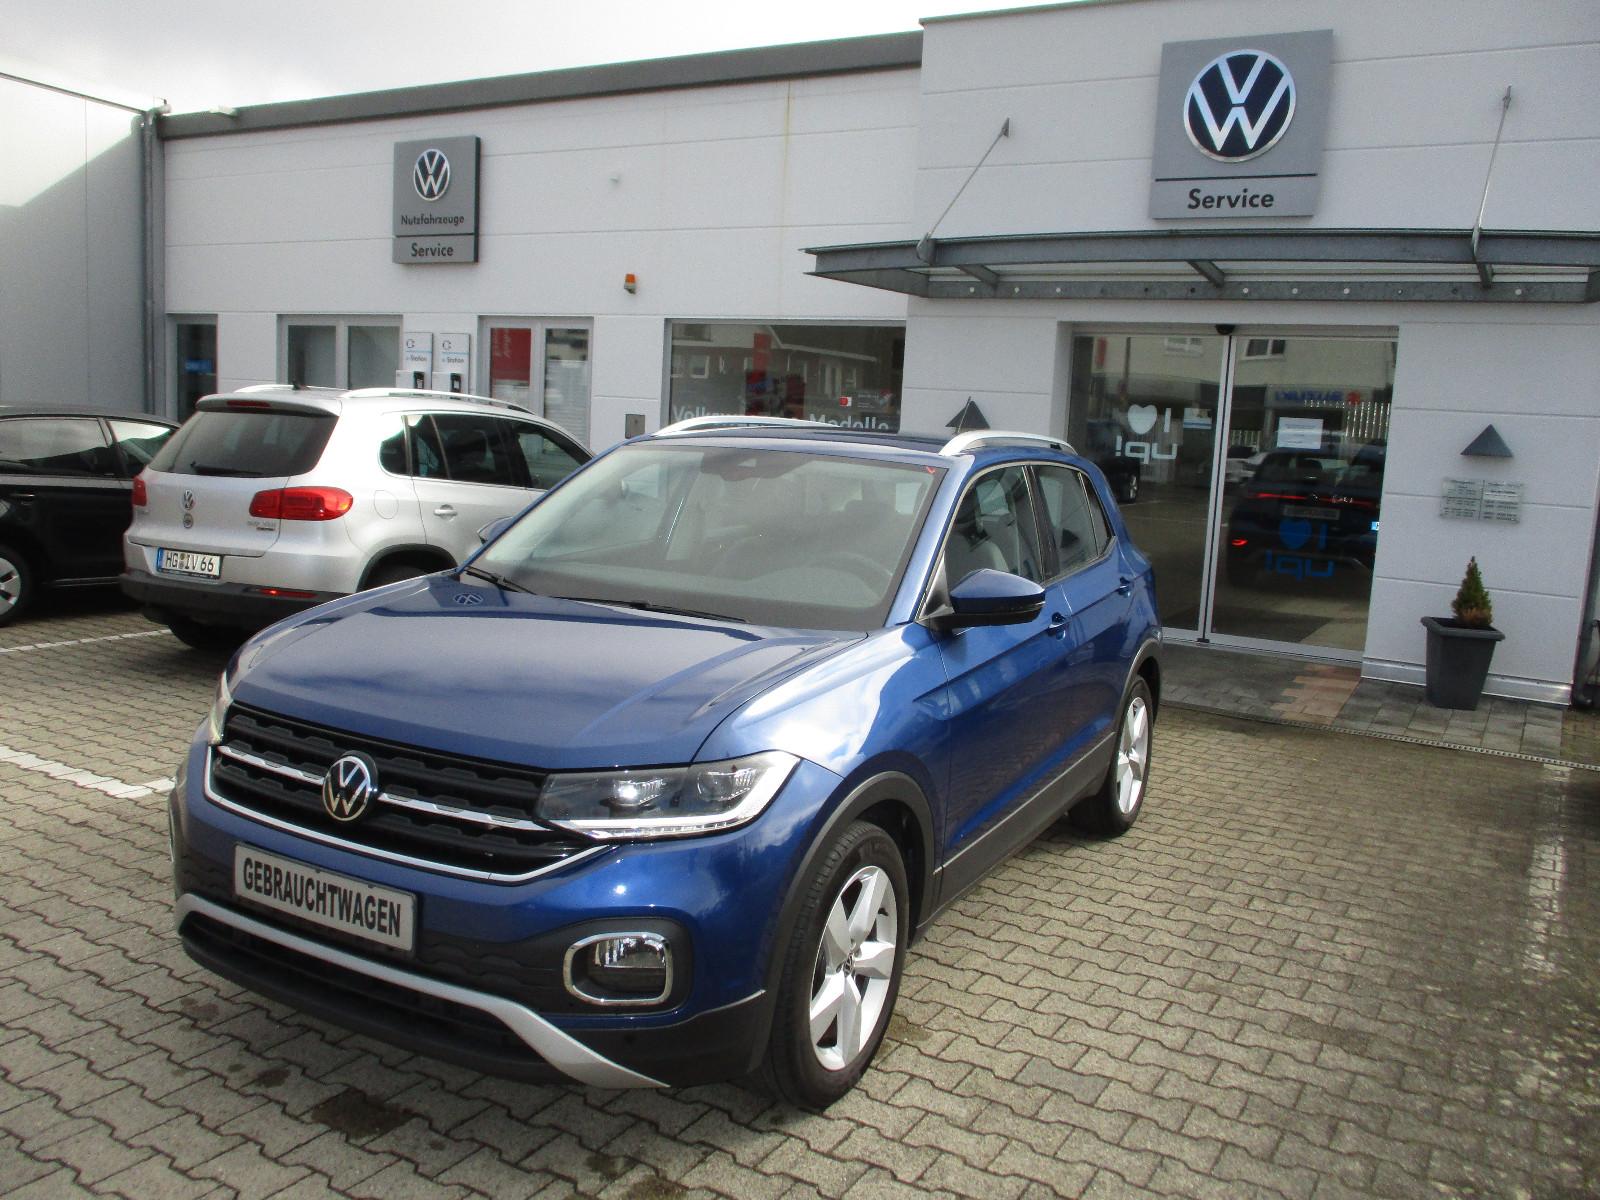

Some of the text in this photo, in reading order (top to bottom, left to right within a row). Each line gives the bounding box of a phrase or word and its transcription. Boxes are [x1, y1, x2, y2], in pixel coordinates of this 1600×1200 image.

[1188, 188, 1275, 209] Service
[401, 213, 465, 228] Nutzfahrzeuge
[411, 242, 454, 257] Service
[165, 550, 179, 568] HG
[200, 557, 214, 572] 66
[243, 857, 401, 938] GEBRAUCHTWAGEN
